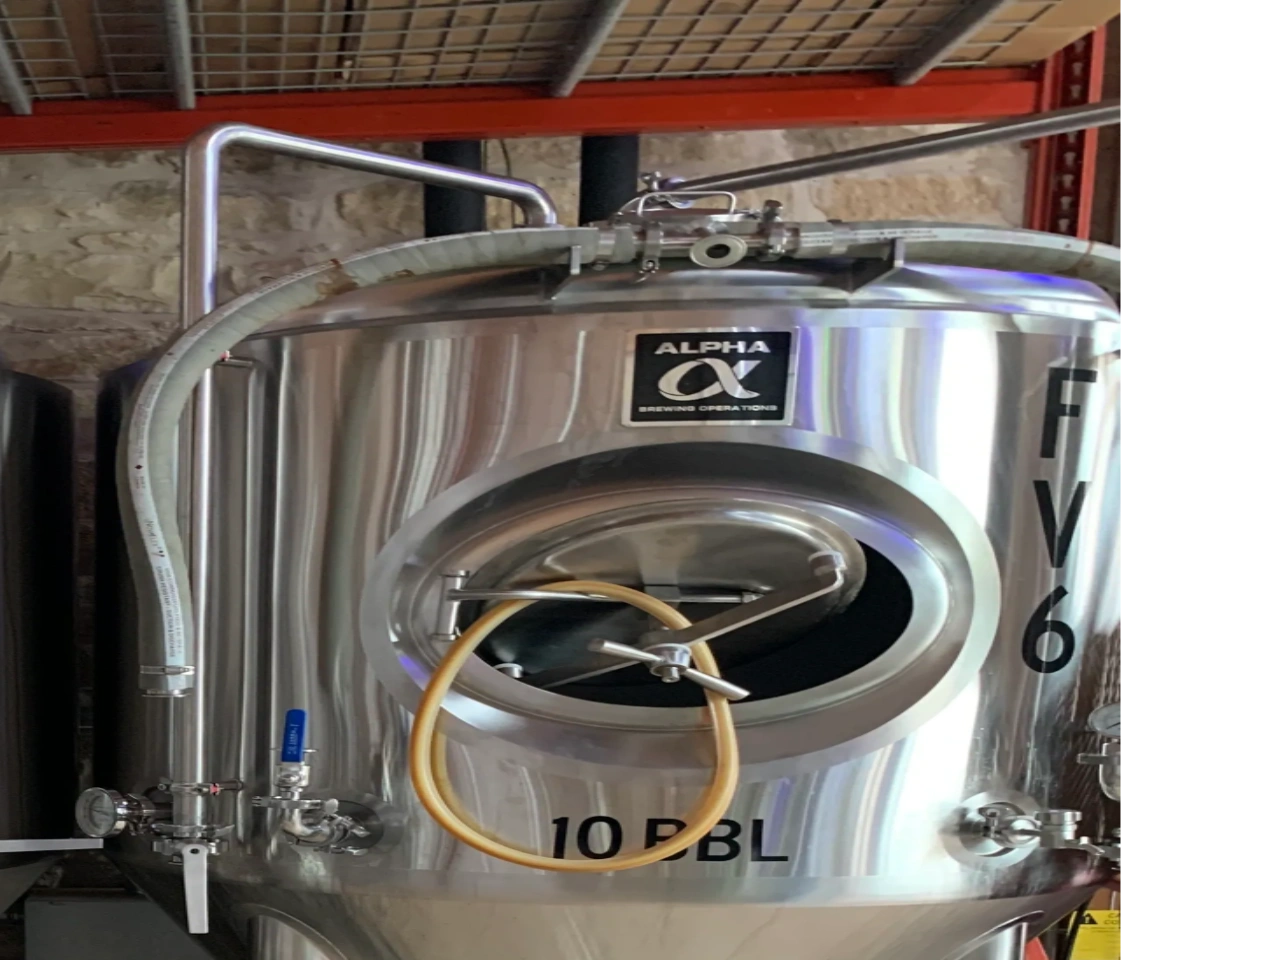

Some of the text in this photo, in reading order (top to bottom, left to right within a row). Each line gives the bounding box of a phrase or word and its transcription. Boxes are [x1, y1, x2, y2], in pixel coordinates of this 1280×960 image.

[654, 340, 771, 354] ALPHA
[638, 404, 778, 413] BREWING OPERATIONS
[552, 815, 623, 860] 10
